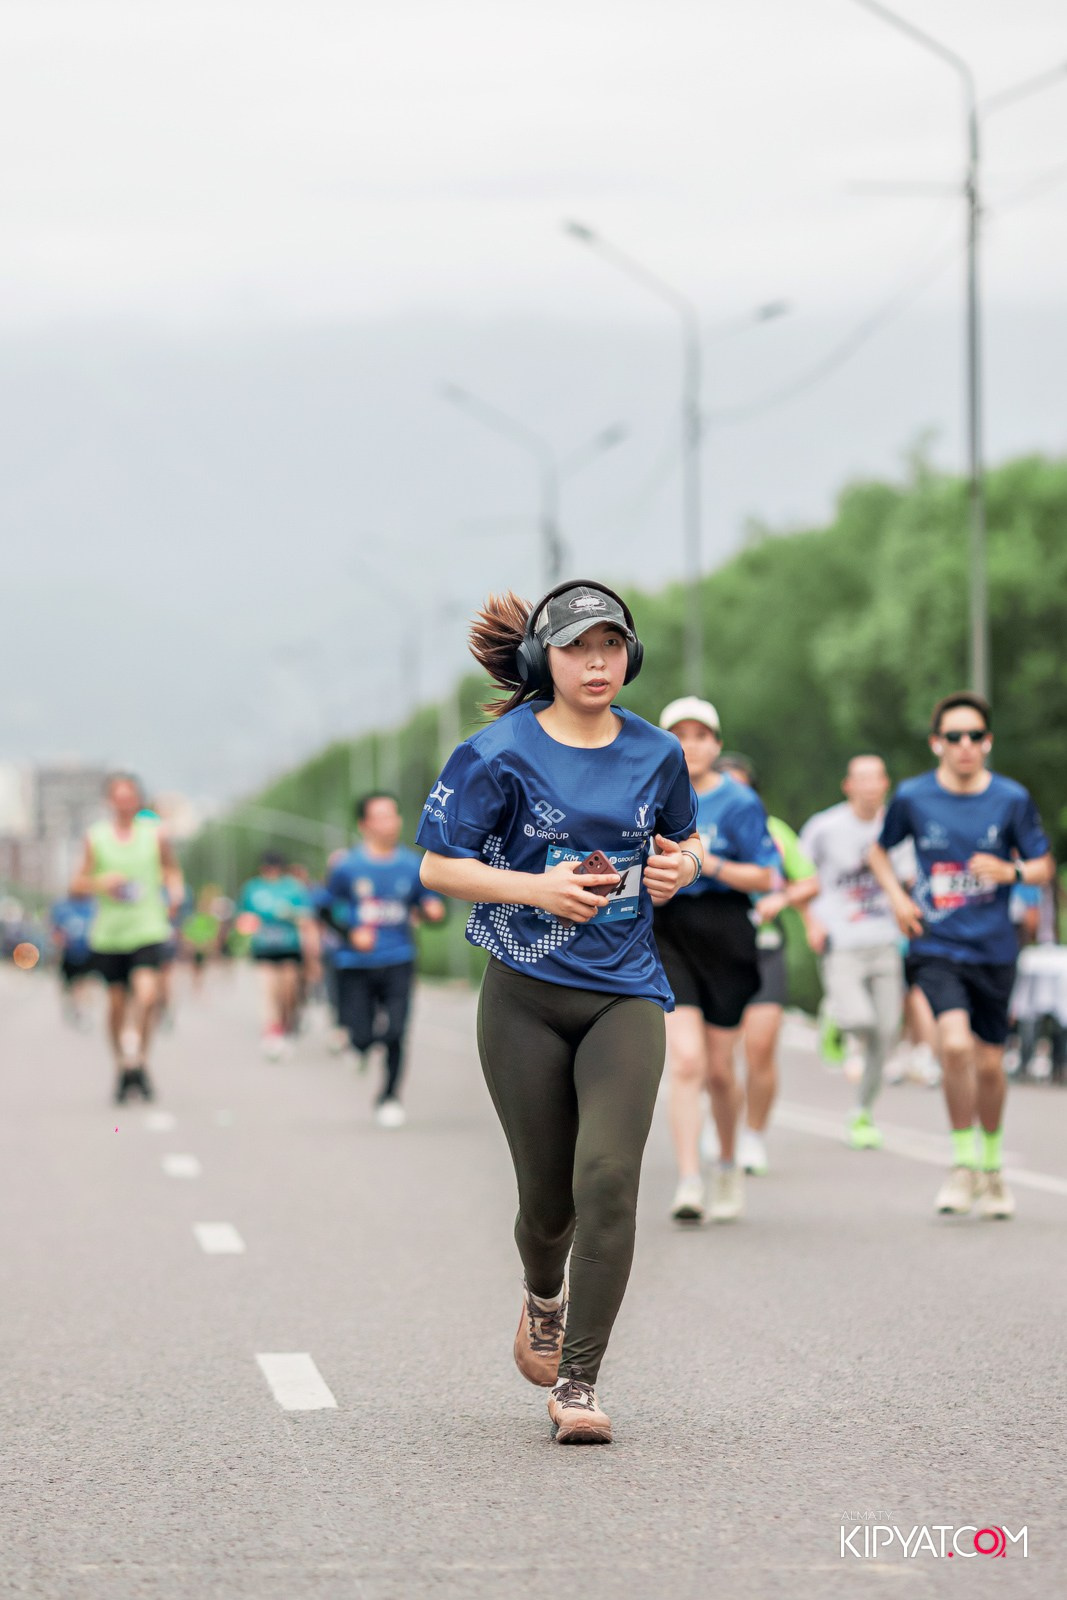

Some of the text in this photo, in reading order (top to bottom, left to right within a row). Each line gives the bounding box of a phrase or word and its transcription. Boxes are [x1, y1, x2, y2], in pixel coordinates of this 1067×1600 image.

[536, 829, 569, 840] GROUP
[621, 830, 630, 838] BI
[552, 850, 579, 862] 5 KM
[617, 855, 635, 863] GROUP
